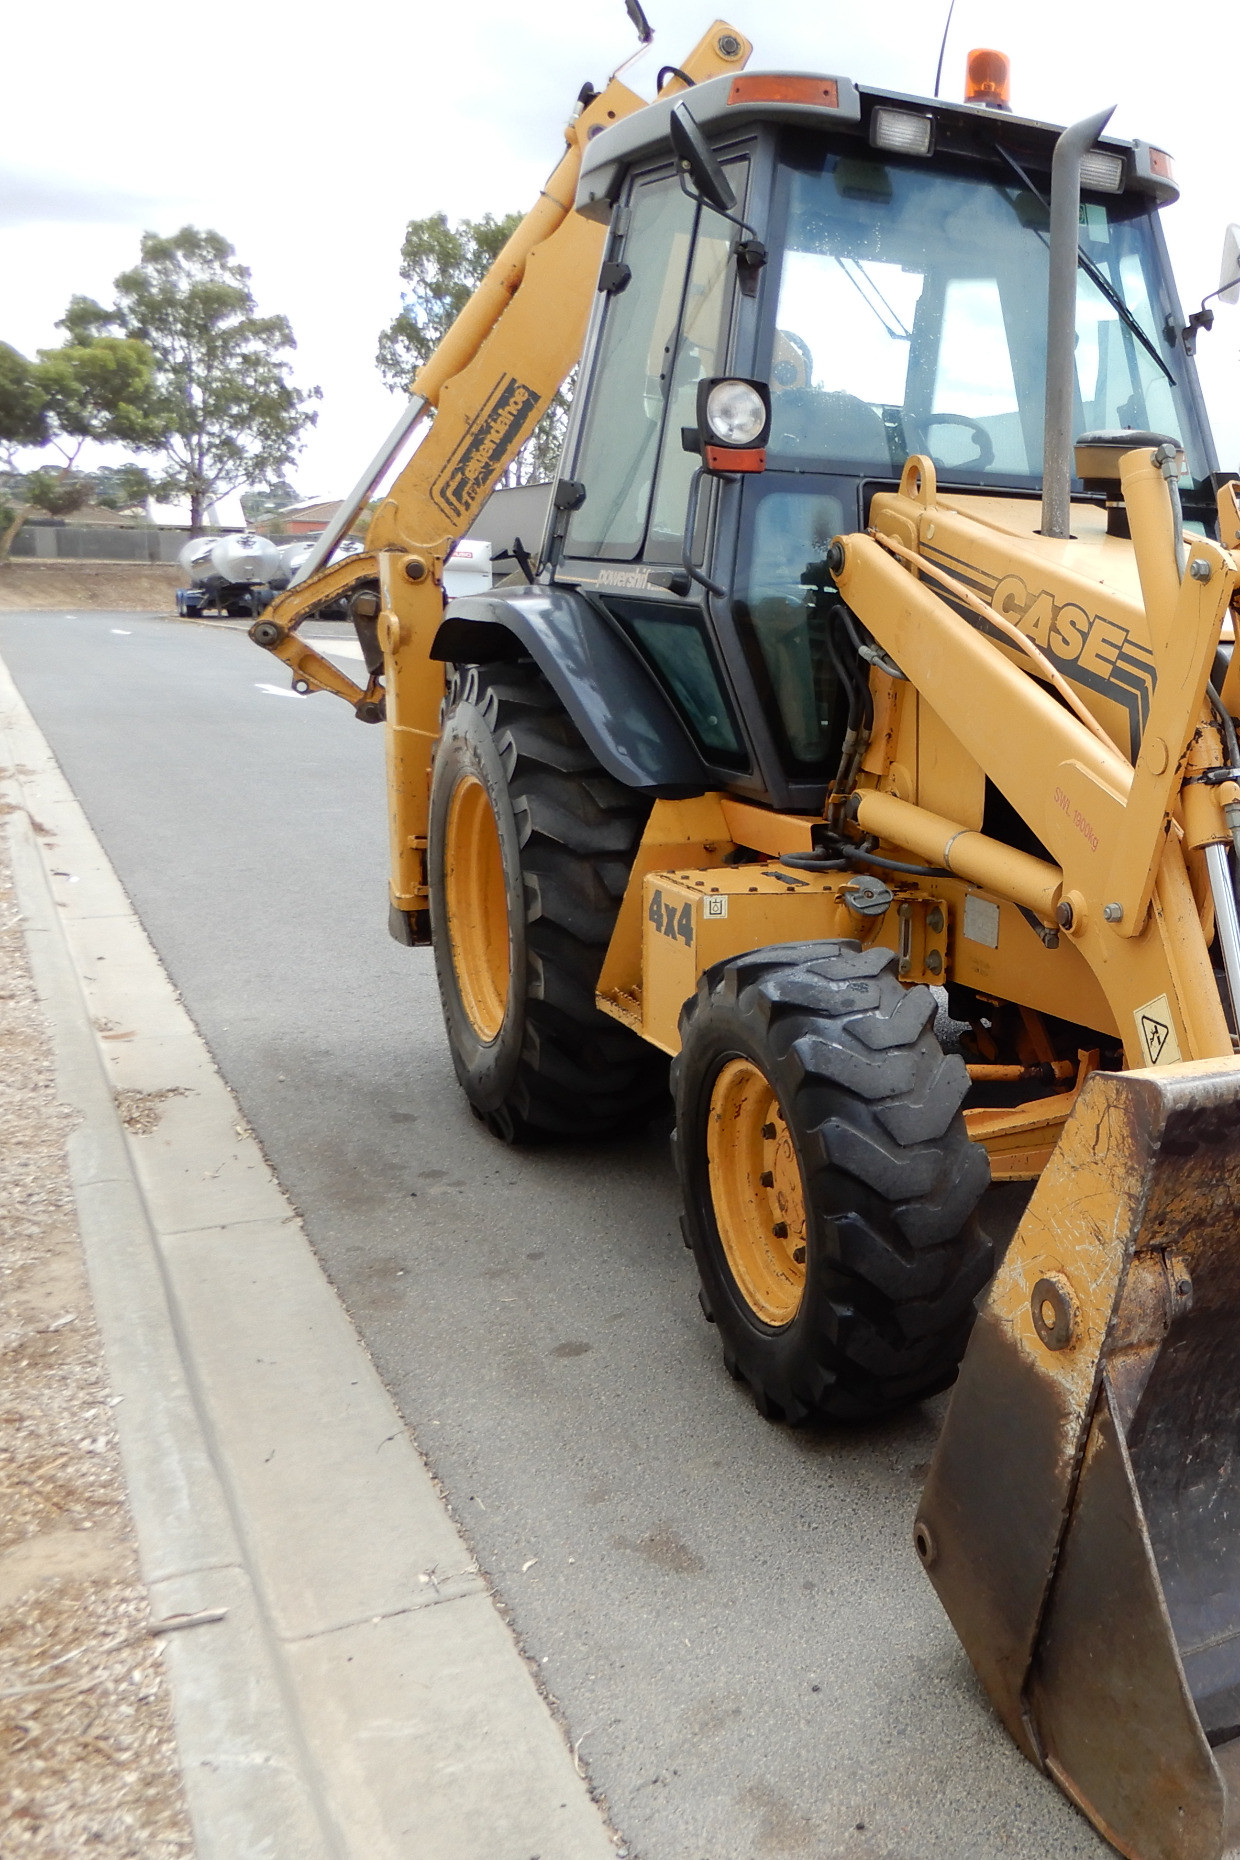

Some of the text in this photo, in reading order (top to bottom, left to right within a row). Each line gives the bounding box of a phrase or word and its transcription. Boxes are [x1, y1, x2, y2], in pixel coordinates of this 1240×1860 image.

[991, 574, 1129, 681] CASE
[1053, 786, 1071, 817] SWL
[648, 889, 694, 948] 4x4
